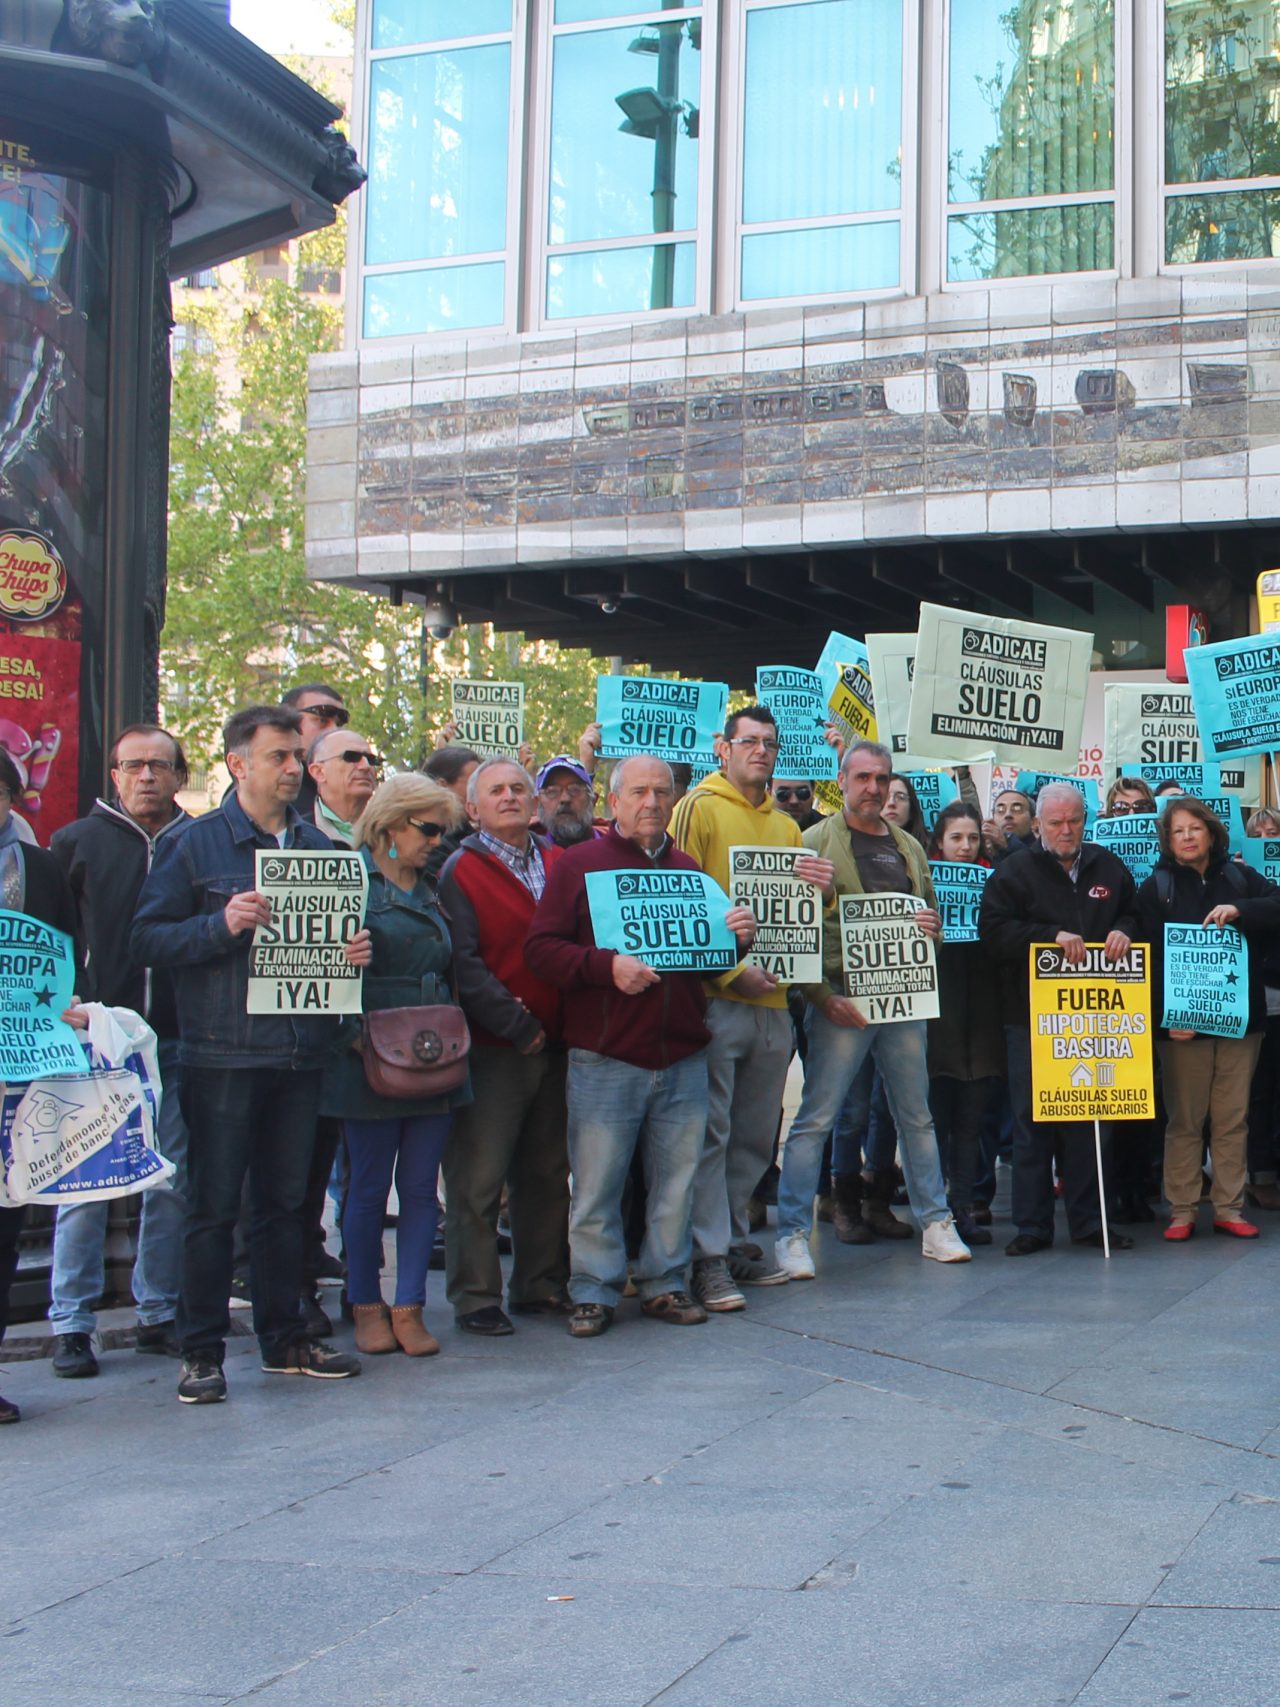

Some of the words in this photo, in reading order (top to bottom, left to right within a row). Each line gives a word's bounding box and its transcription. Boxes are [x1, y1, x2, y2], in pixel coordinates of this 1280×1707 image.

[979, 633, 1045, 662] ADICAE
[775, 671, 823, 692] ADICAE
[960, 661, 1043, 691] CLÁUSULAS
[466, 686, 519, 702] ADICAE
[639, 683, 699, 704] ADICAE
[774, 694, 823, 710] EUROPA
[1225, 687, 1237, 700] SI
[958, 684, 1041, 724] SUELO
[1230, 709, 1248, 719] NOS
[1249, 705, 1269, 716] TIENE
[455, 707, 519, 724] CLÁUSULAS
[621, 705, 697, 726] CLÁUSULAS
[838, 697, 870, 736] FUERA
[1232, 717, 1247, 727] QUE
[454, 721, 519, 746] SUELO
[619, 721, 697, 750] SUELO
[937, 716, 1017, 741] ELIMINACIÓN
[1020, 730, 1057, 746] ¡¡YA!!
[1213, 729, 1251, 744] CLÁUSULA
[1252, 724, 1275, 736] SUELO
[780, 745, 812, 756] SUELO
[1155, 765, 1202, 780] ADICAE
[286, 859, 361, 881] ADICAE
[931, 866, 987, 884] ADICAE
[637, 875, 704, 893] ADICAE
[735, 879, 815, 898] CLÁUSULAS
[620, 900, 708, 921] CLÁUSULAS
[260, 913, 361, 945] SUELO
[623, 919, 711, 950] SUELO
[846, 925, 926, 943] CLÁUSULAS
[1184, 929, 1242, 946] ADICAE
[789, 943, 816, 952] TOTAL
[847, 939, 929, 969] SUELO
[696, 951, 729, 968] ¡¡YA!!
[1170, 952, 1183, 963] SI
[1182, 951, 1238, 966] EUROPA
[262, 963, 327, 977] DEVOLUCIÓN
[326, 965, 357, 977] TOTAL
[849, 966, 931, 987] ELIMINACIÓN
[1170, 971, 1187, 979] NOS
[1189, 971, 1210, 980] TIENE
[856, 984, 906, 996] DEVOLUCIÓN
[907, 982, 932, 992] TOTAL
[1170, 978, 1185, 986] QUE
[1186, 979, 1223, 988] ESCUCHAR
[276, 981, 331, 1009] ¡YA!
[1057, 988, 1125, 1011] FUERA
[1173, 986, 1236, 1004] CLÁUSULAS
[868, 996, 913, 1020] ¡YA!
[1188, 999, 1222, 1013] SUELO
[1037, 1012, 1146, 1036] HIPOTECAS
[1166, 1009, 1242, 1028] ELIMINACIÓN
[1052, 1036, 1134, 1060] BASURA
[43, 1057, 79, 1072] TOTAL
[1039, 1086, 1108, 1103] CLÁUSULAS
[1110, 1088, 1148, 1102] SUELO
[1040, 1104, 1086, 1117] ABUSOS
[1088, 1103, 1149, 1116] BANCARIOS
